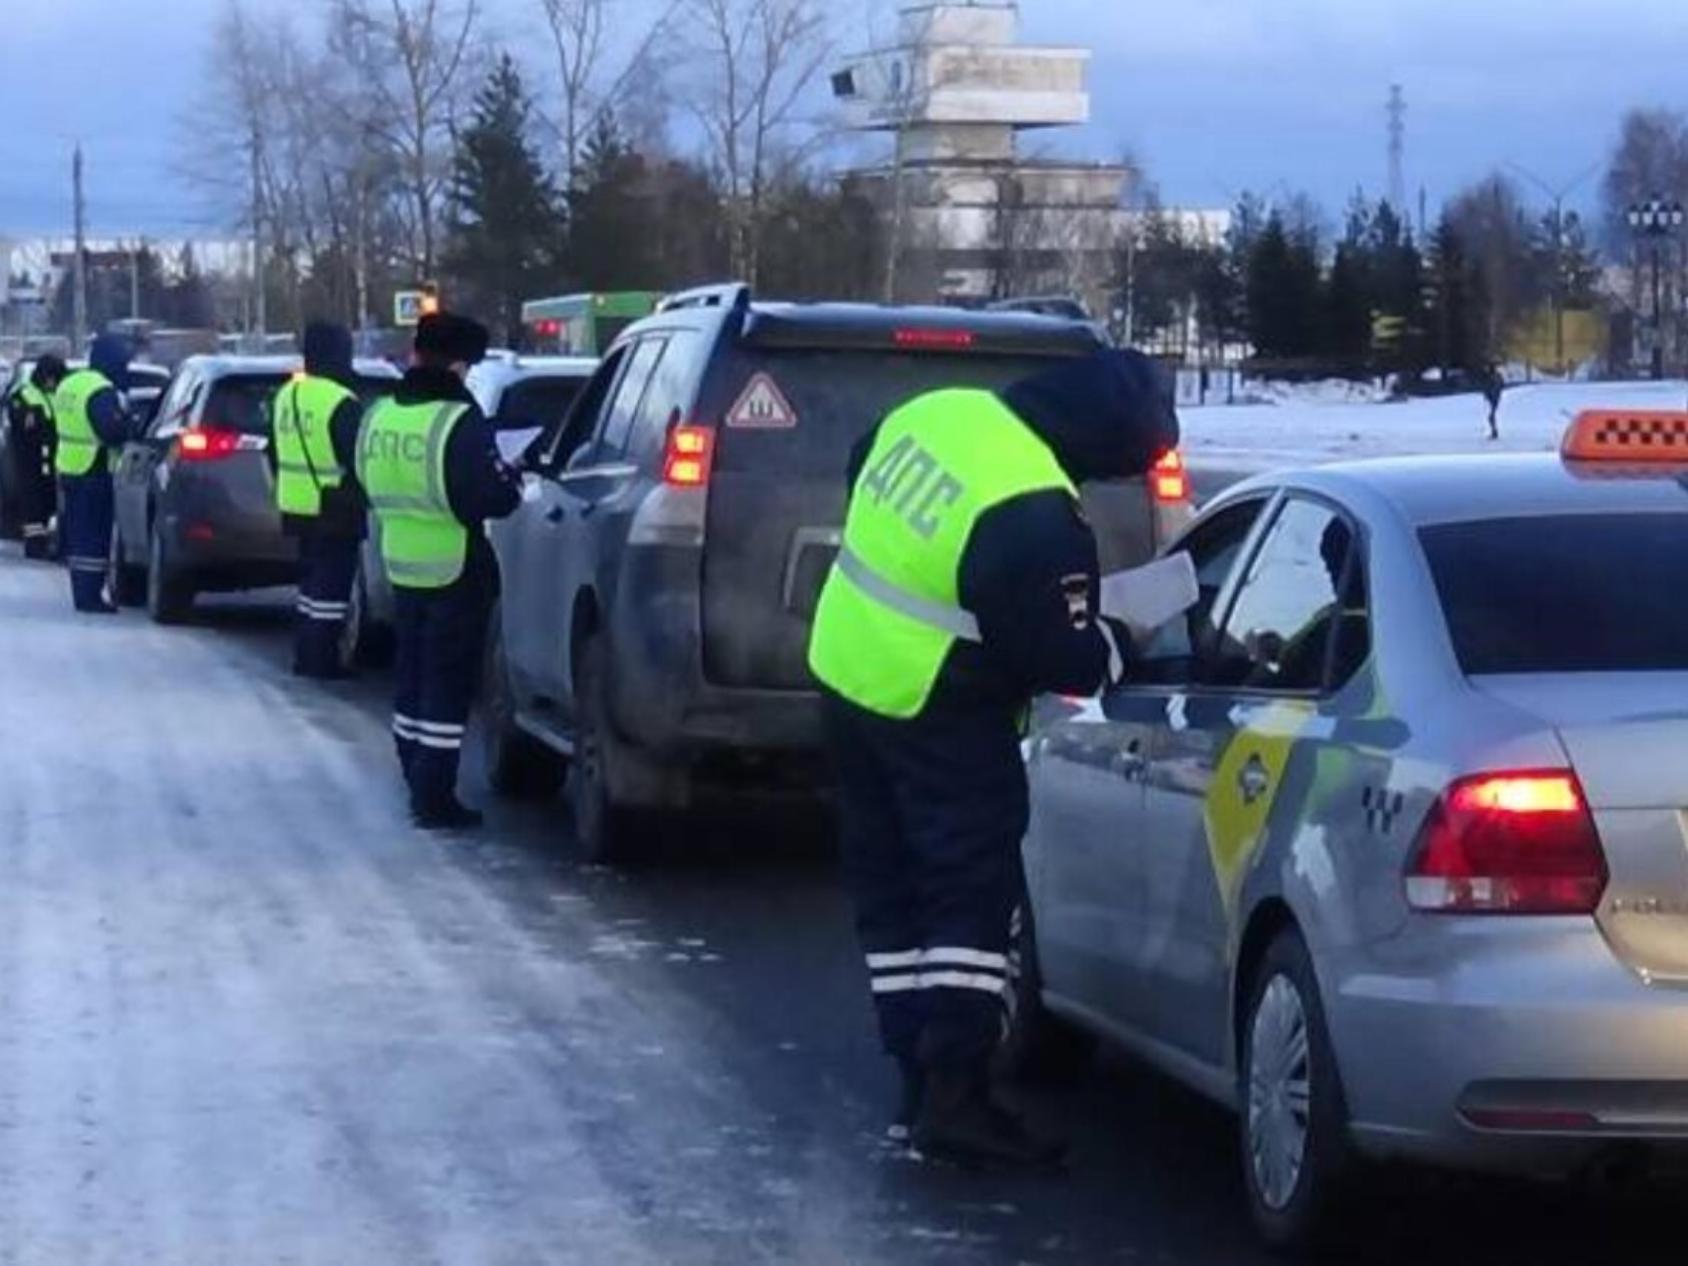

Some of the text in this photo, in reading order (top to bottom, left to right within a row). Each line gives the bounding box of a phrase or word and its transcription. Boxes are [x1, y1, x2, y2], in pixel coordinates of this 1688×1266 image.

[749, 400, 773, 419] Ш
[364, 428, 425, 463] ДПС
[861, 434, 964, 538] ДПС
